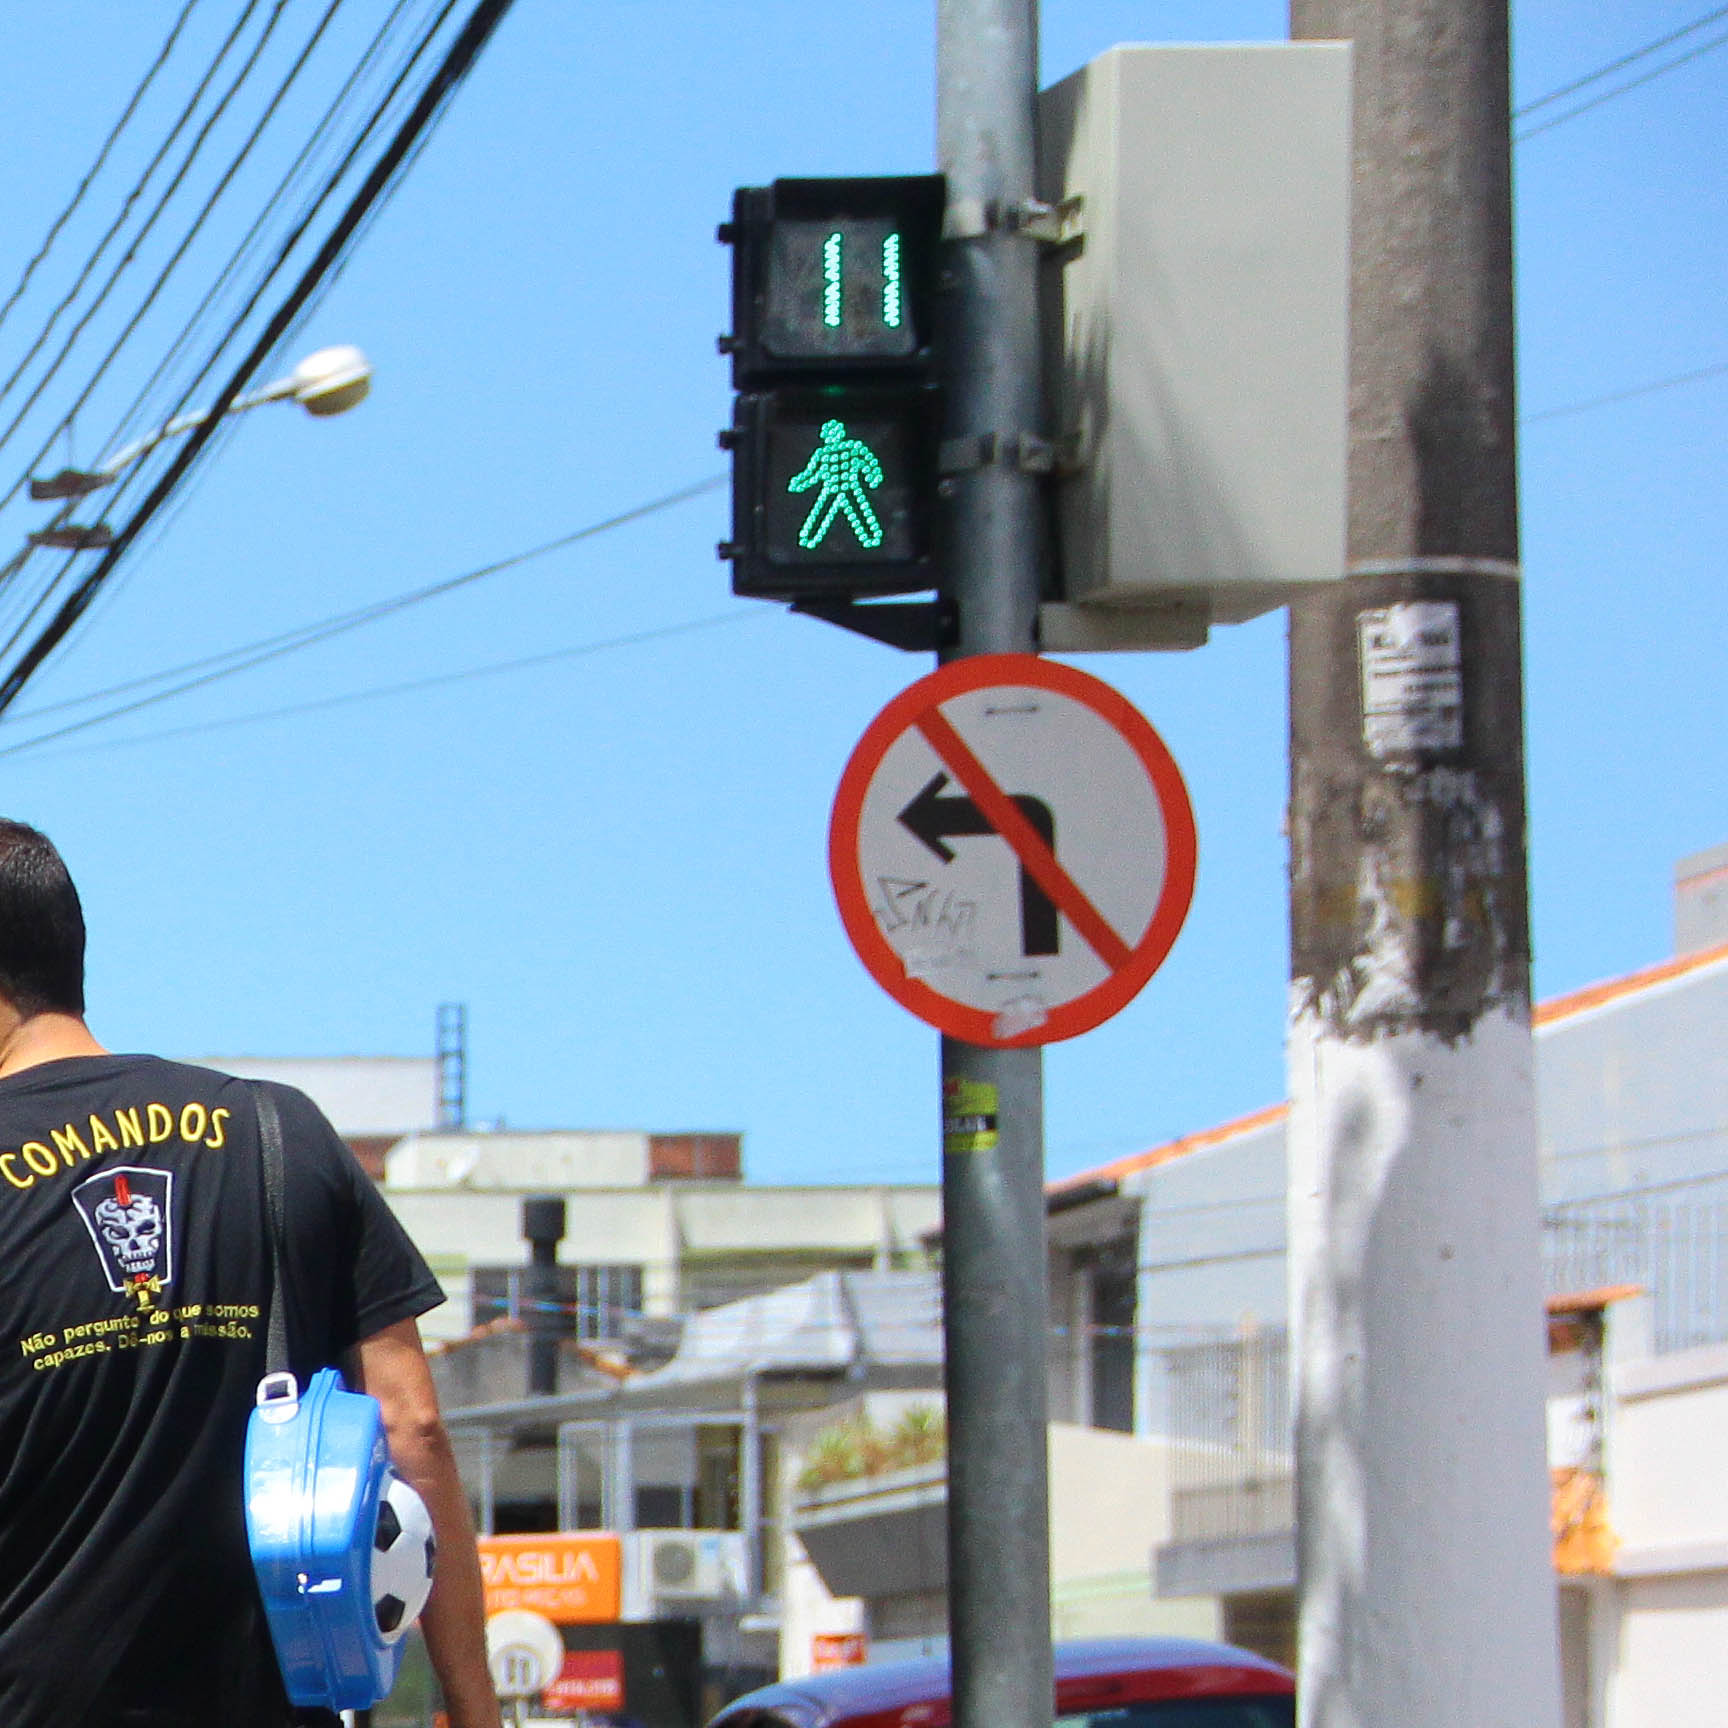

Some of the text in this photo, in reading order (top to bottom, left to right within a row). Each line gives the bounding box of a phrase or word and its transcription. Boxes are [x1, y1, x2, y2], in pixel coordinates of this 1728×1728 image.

[824, 233, 899, 327] 11
[20, 1332, 57, 1357] Não
[149, 1308, 170, 1325] do
[173, 1304, 202, 1323] que
[205, 1303, 260, 1319] somos
[32, 1340, 112, 1371] capazes.
[179, 1325, 191, 1339] a
[478, 1551, 600, 1584] RASILIA
